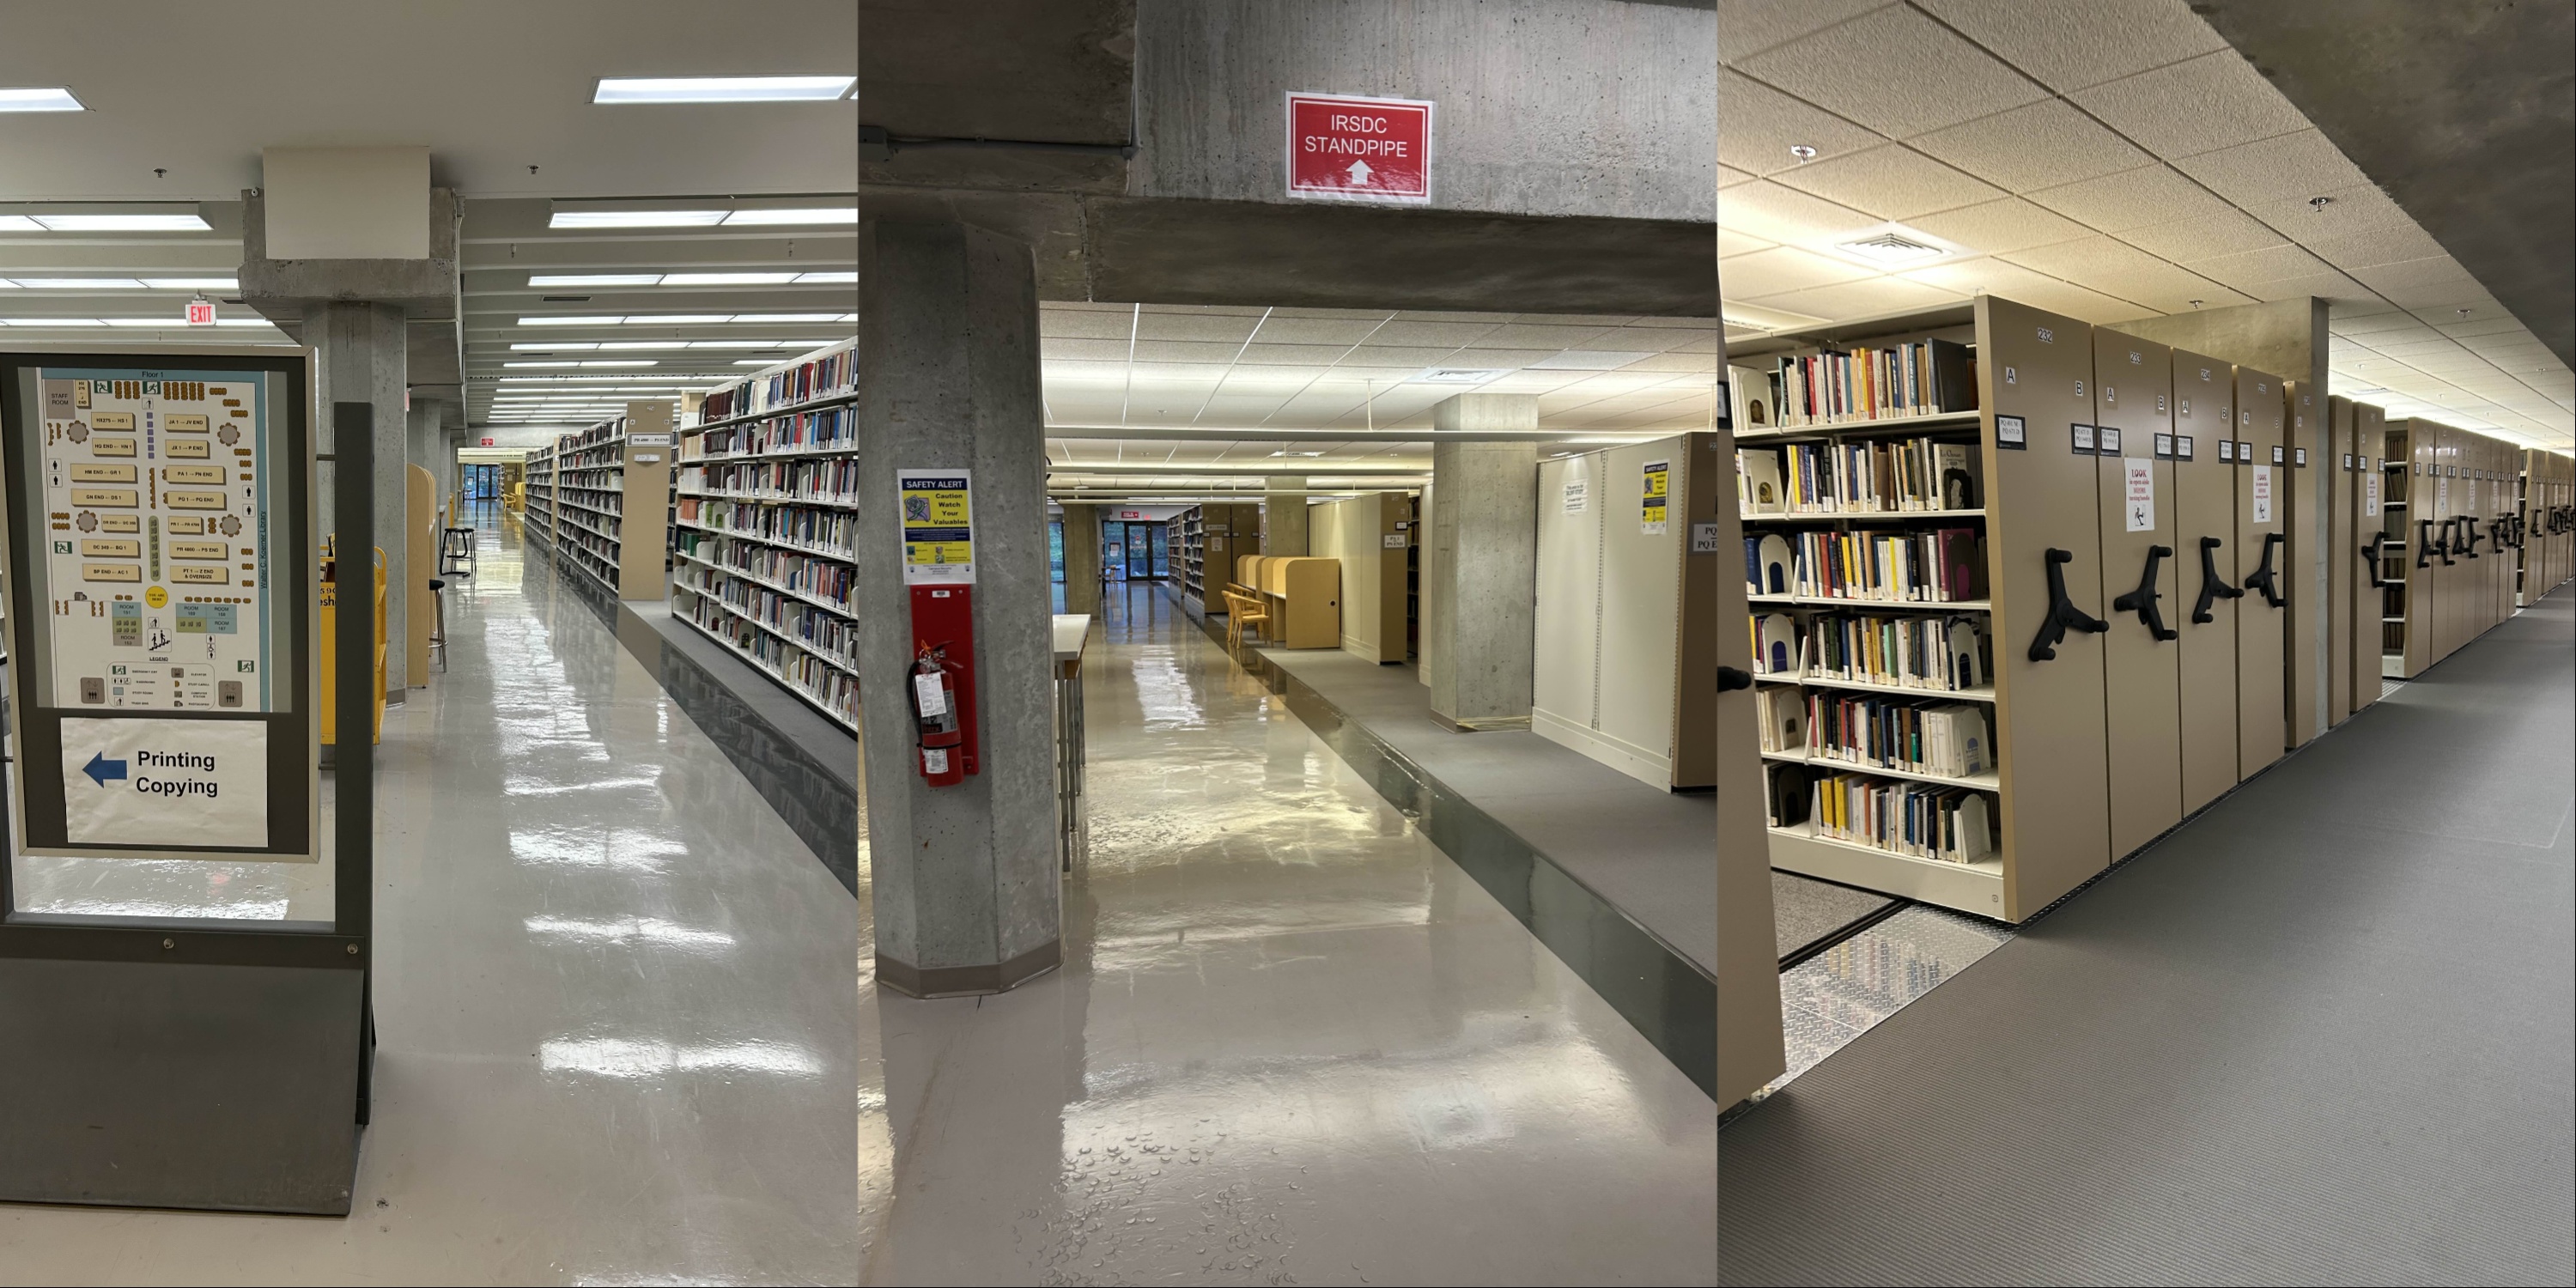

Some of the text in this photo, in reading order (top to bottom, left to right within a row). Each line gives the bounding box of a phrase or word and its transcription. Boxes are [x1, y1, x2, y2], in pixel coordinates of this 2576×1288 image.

[1331, 114, 1387, 134] IRSDC
[1305, 136, 1408, 158] STANDPIPE
[190, 306, 212, 323] EXIT
[2038, 328, 2052, 343] 232
[2131, 352, 2141, 364] 233
[2007, 368, 2015, 383] A
[2201, 370, 2209, 379] 234
[2076, 382, 2082, 395] B
[2108, 388, 2113, 399] A
[2159, 397, 2163, 408] B
[2183, 401, 2188, 411] A
[2223, 408, 2226, 418] B
[2131, 469, 2147, 478] LOOK
[1705, 527, 1717, 535] PQ
[1698, 541, 1710, 550] PQ
[137, 750, 215, 771] Printing
[136, 777, 218, 798] Copying
